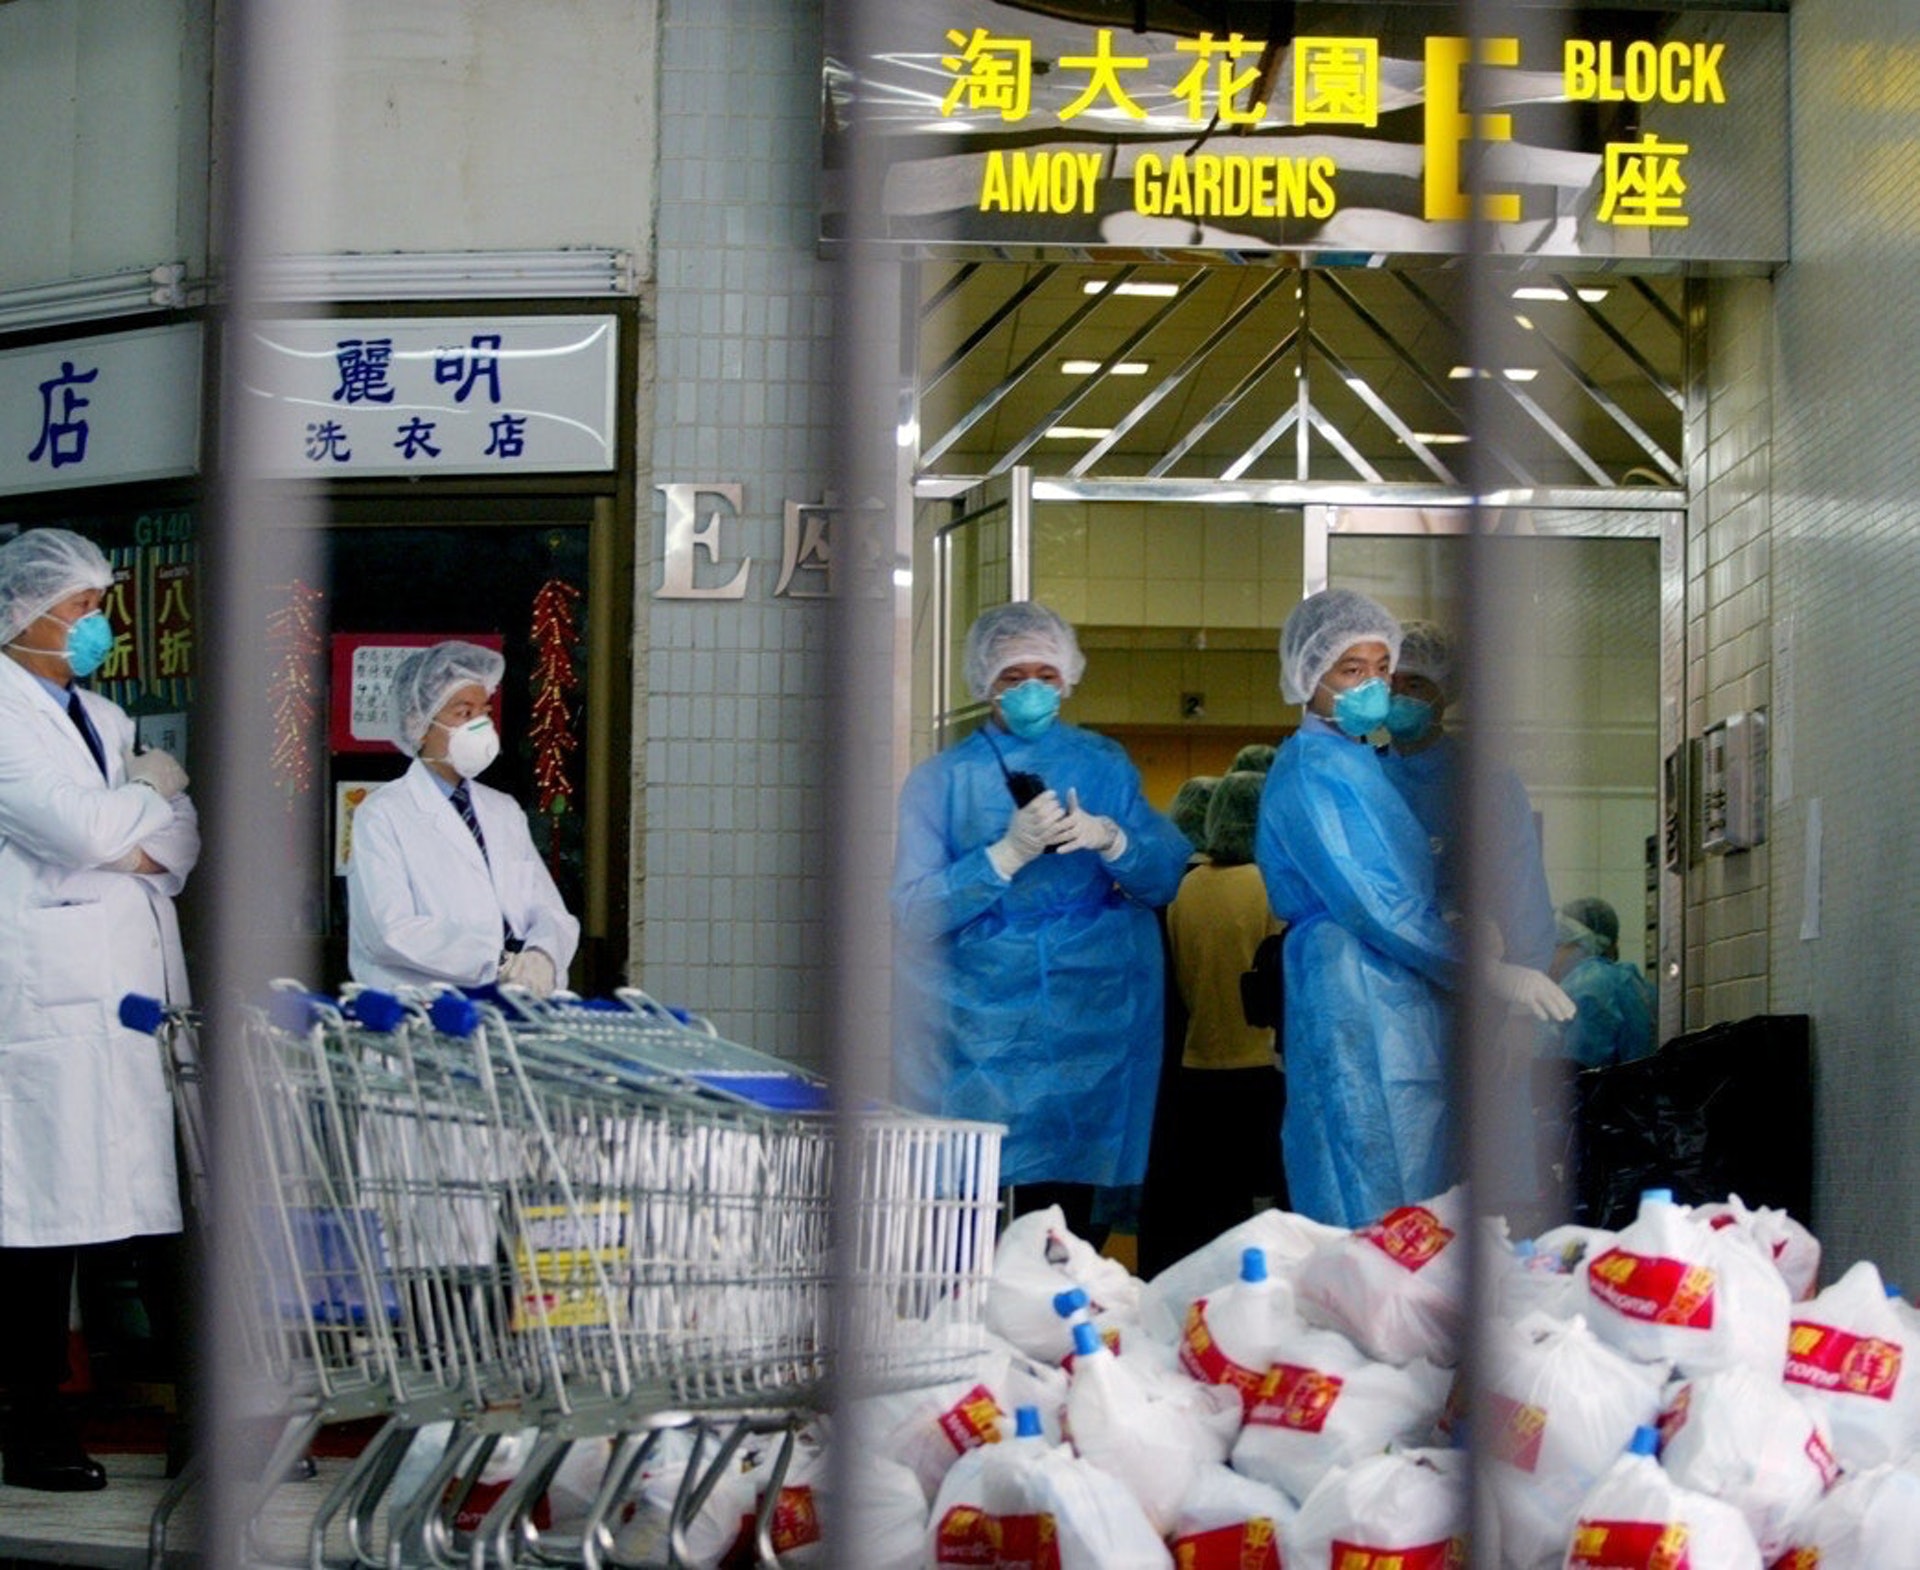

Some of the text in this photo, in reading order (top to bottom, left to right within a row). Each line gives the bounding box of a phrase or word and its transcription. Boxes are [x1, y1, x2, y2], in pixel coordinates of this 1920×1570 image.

[941, 28, 1378, 127] 淘大花園
[1565, 39, 1725, 103] BLOCK
[1424, 36, 1520, 222] E
[980, 150, 1336, 219] AMOY GARDENS
[1596, 133, 1690, 226] 座
[27, 361, 98, 468] 店
[332, 334, 502, 404] 麗明
[305, 414, 528, 462] 洗衣店
[653, 483, 751, 599] E
[158, 578, 194, 676] 八折
